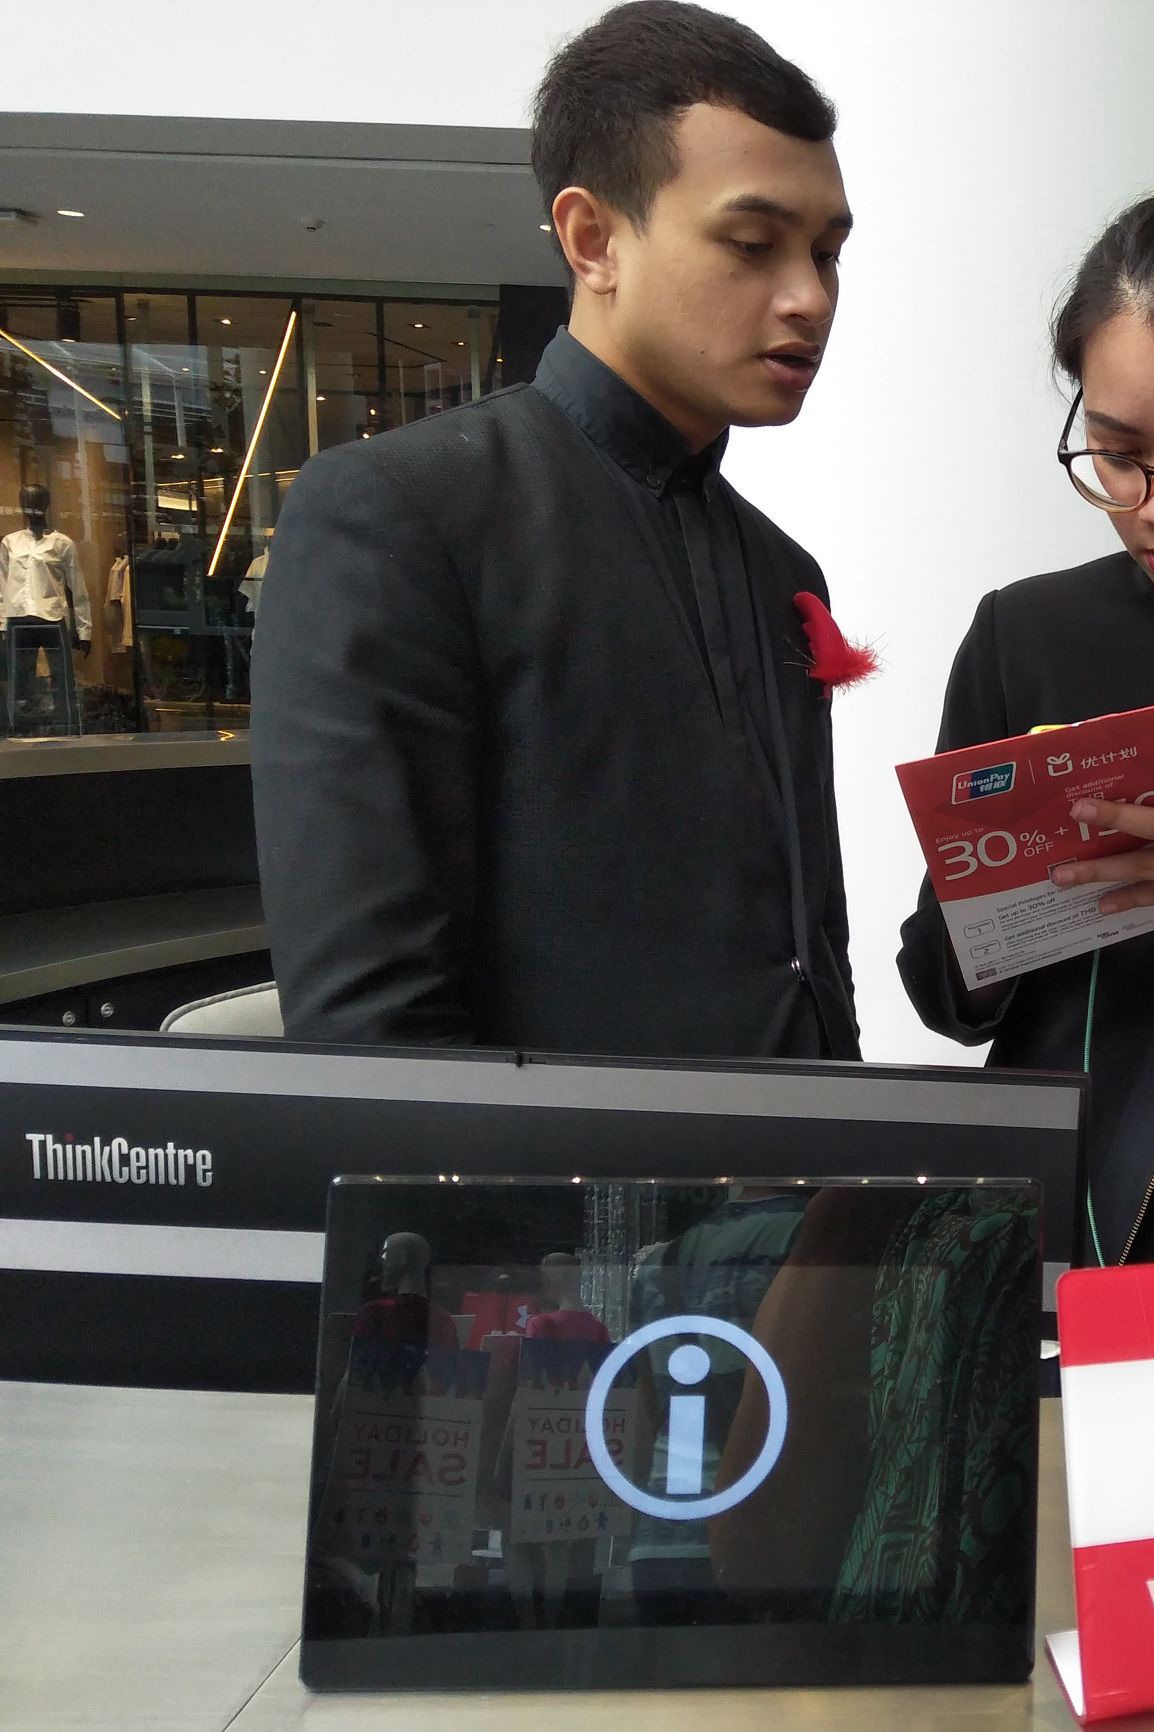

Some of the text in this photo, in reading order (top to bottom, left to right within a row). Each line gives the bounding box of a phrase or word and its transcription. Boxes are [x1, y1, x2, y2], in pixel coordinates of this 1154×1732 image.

[1080, 746, 1138, 769] 优计划
[957, 773, 1010, 789] UnionPay
[935, 834, 959, 844] Enjoy
[961, 830, 972, 838] up
[1023, 841, 1054, 858] OFF
[25, 1133, 213, 1187] ThinkCentre
